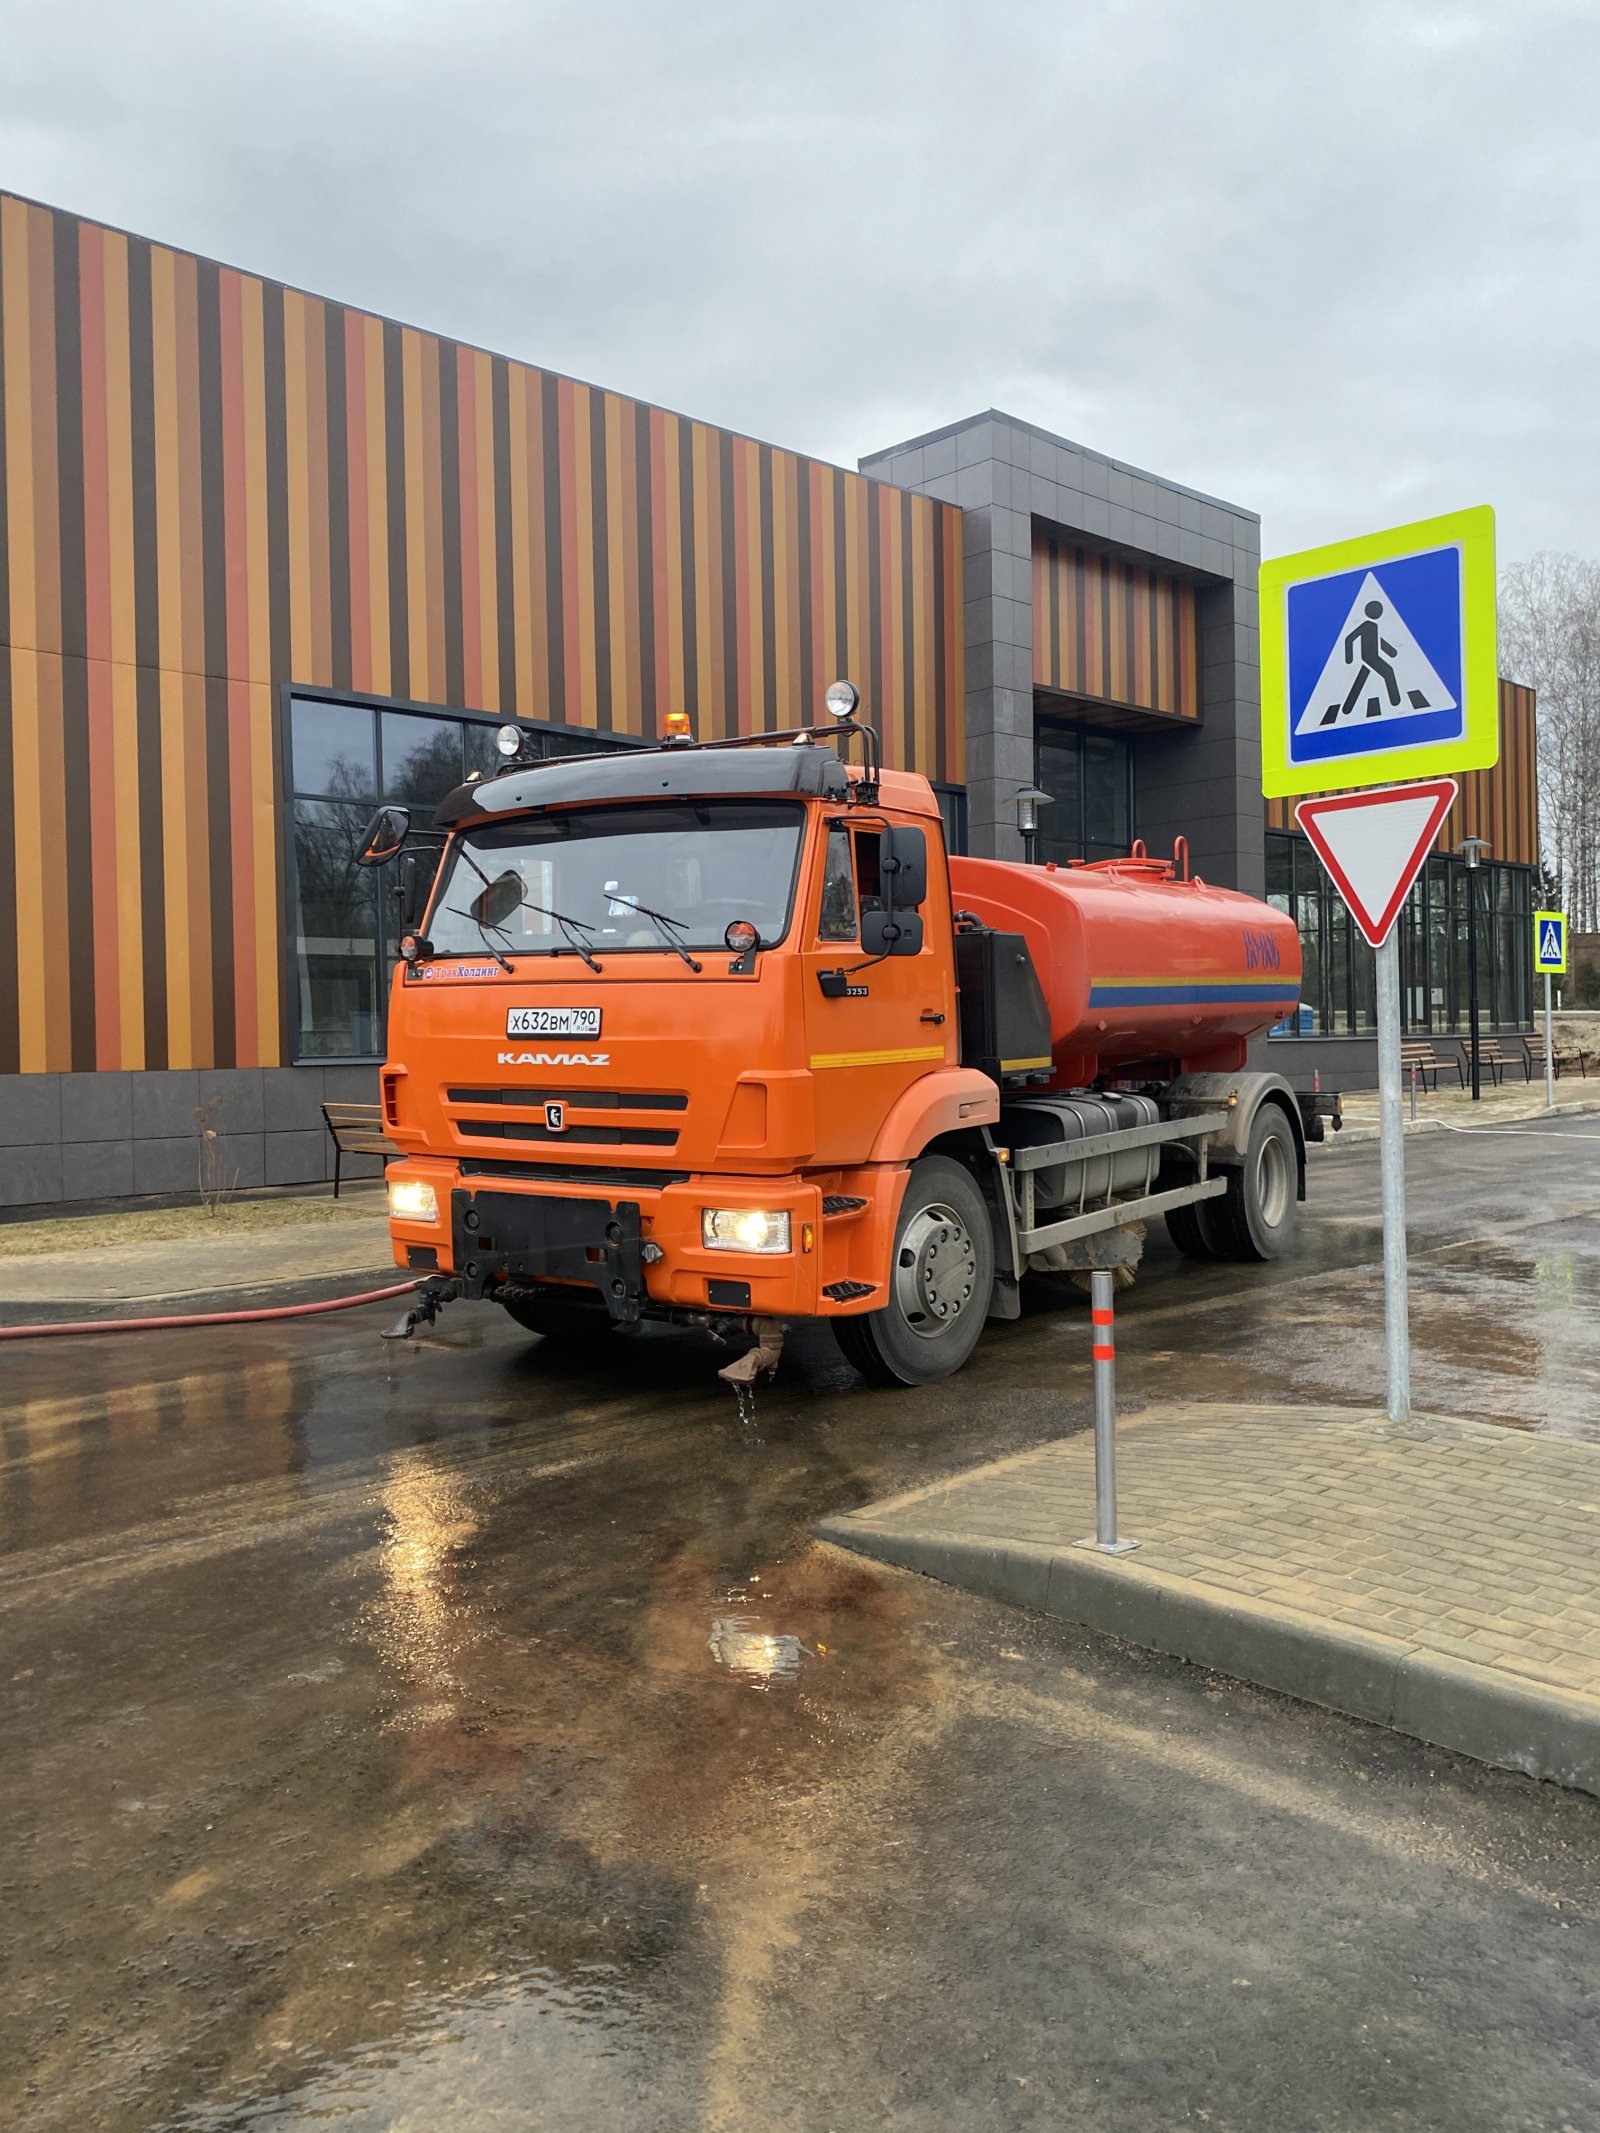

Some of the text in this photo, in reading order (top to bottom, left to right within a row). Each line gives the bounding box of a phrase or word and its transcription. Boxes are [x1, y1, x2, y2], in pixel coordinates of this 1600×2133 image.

[436, 966, 498, 980] ТракХолдинг
[512, 1010, 596, 1030] Х632ВМ 790
[497, 1053, 610, 1066] KAMAZ
